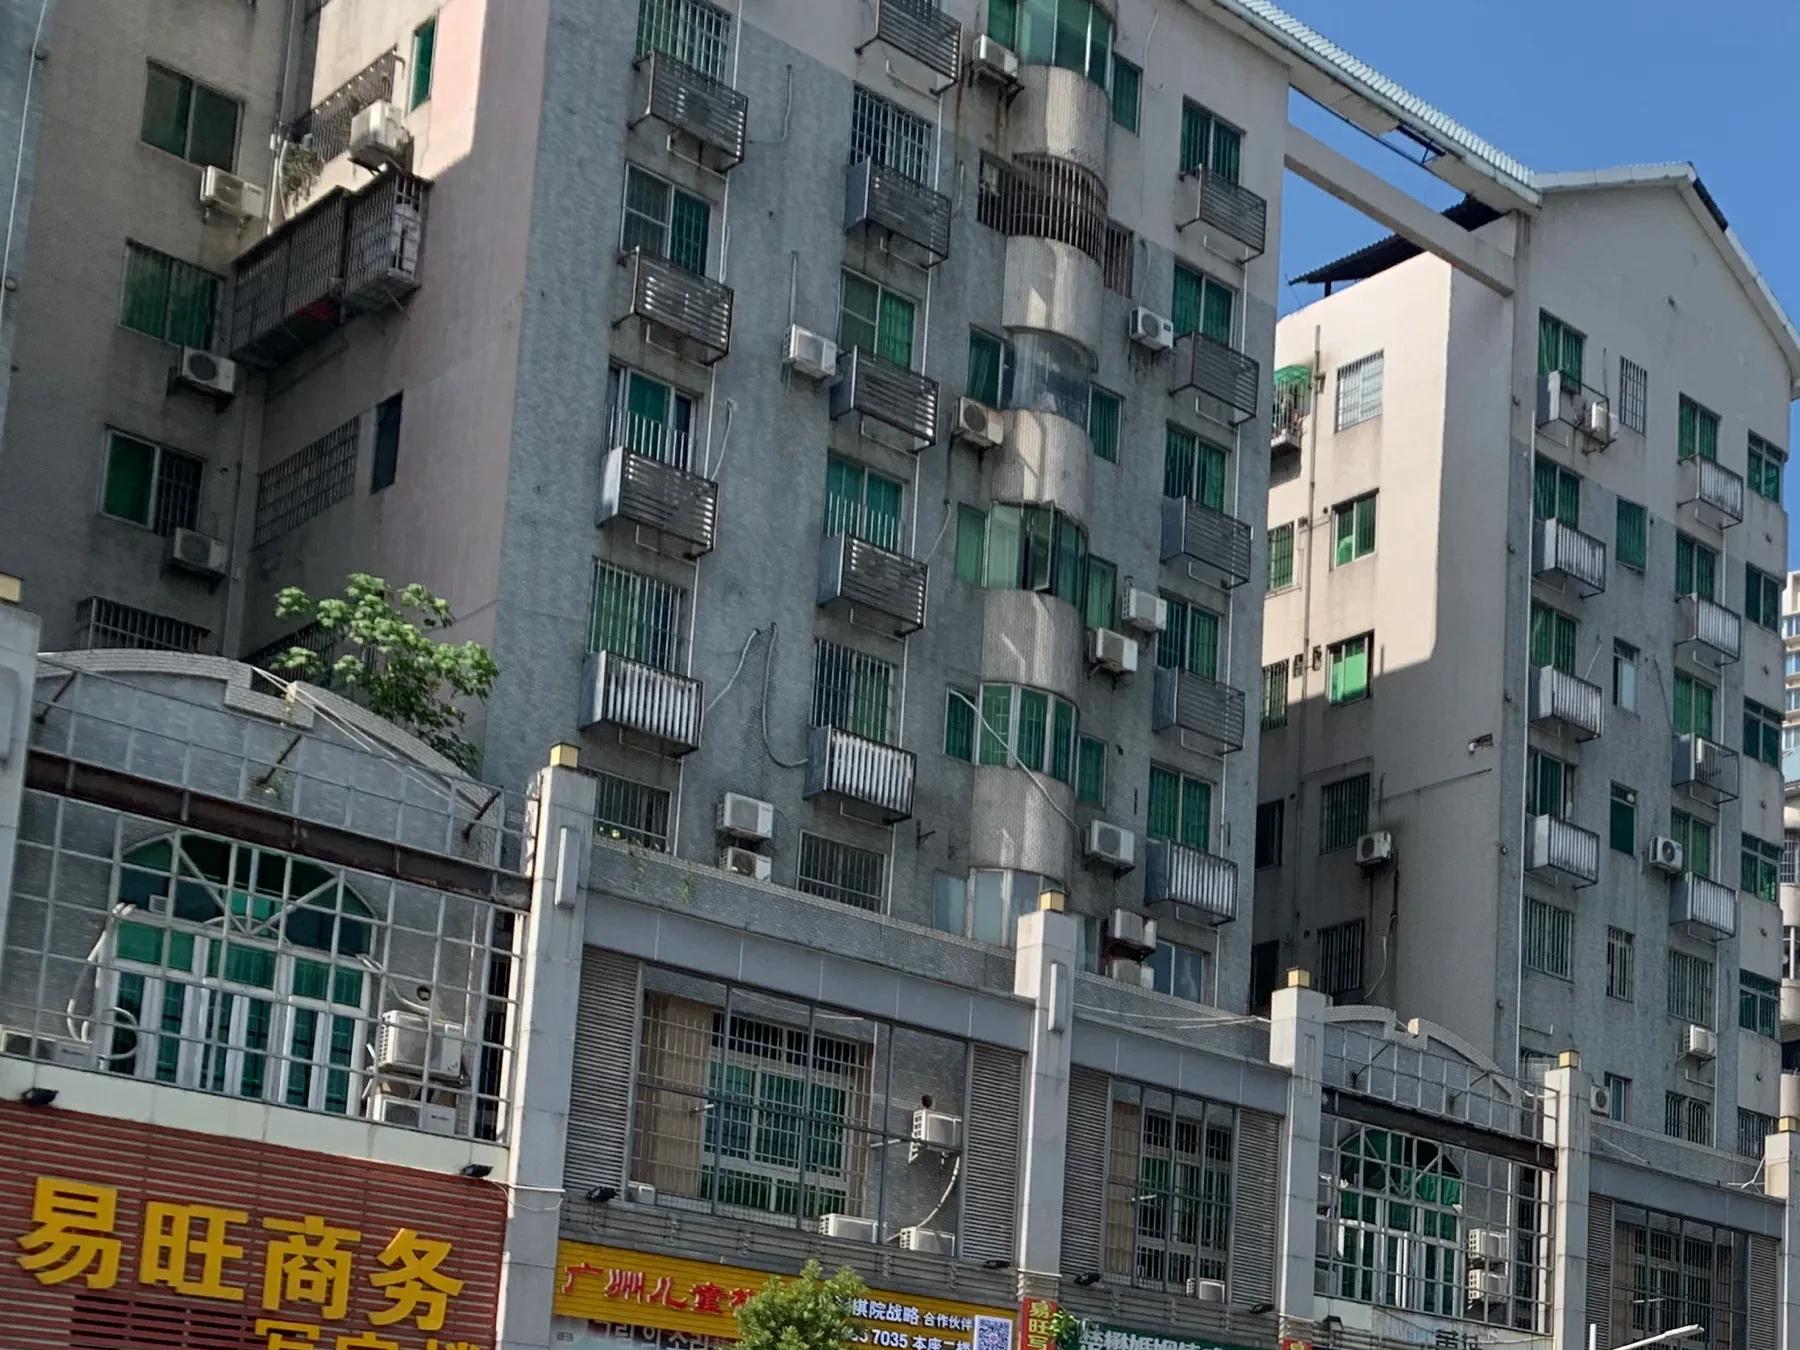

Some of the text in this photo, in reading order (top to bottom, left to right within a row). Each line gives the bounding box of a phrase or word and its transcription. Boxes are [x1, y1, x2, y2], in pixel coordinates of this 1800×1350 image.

[15, 1174, 467, 1332] 易旺商务
[923, 1311, 974, 1332] 合作伙伴
[872, 1328, 909, 1350] 7035
